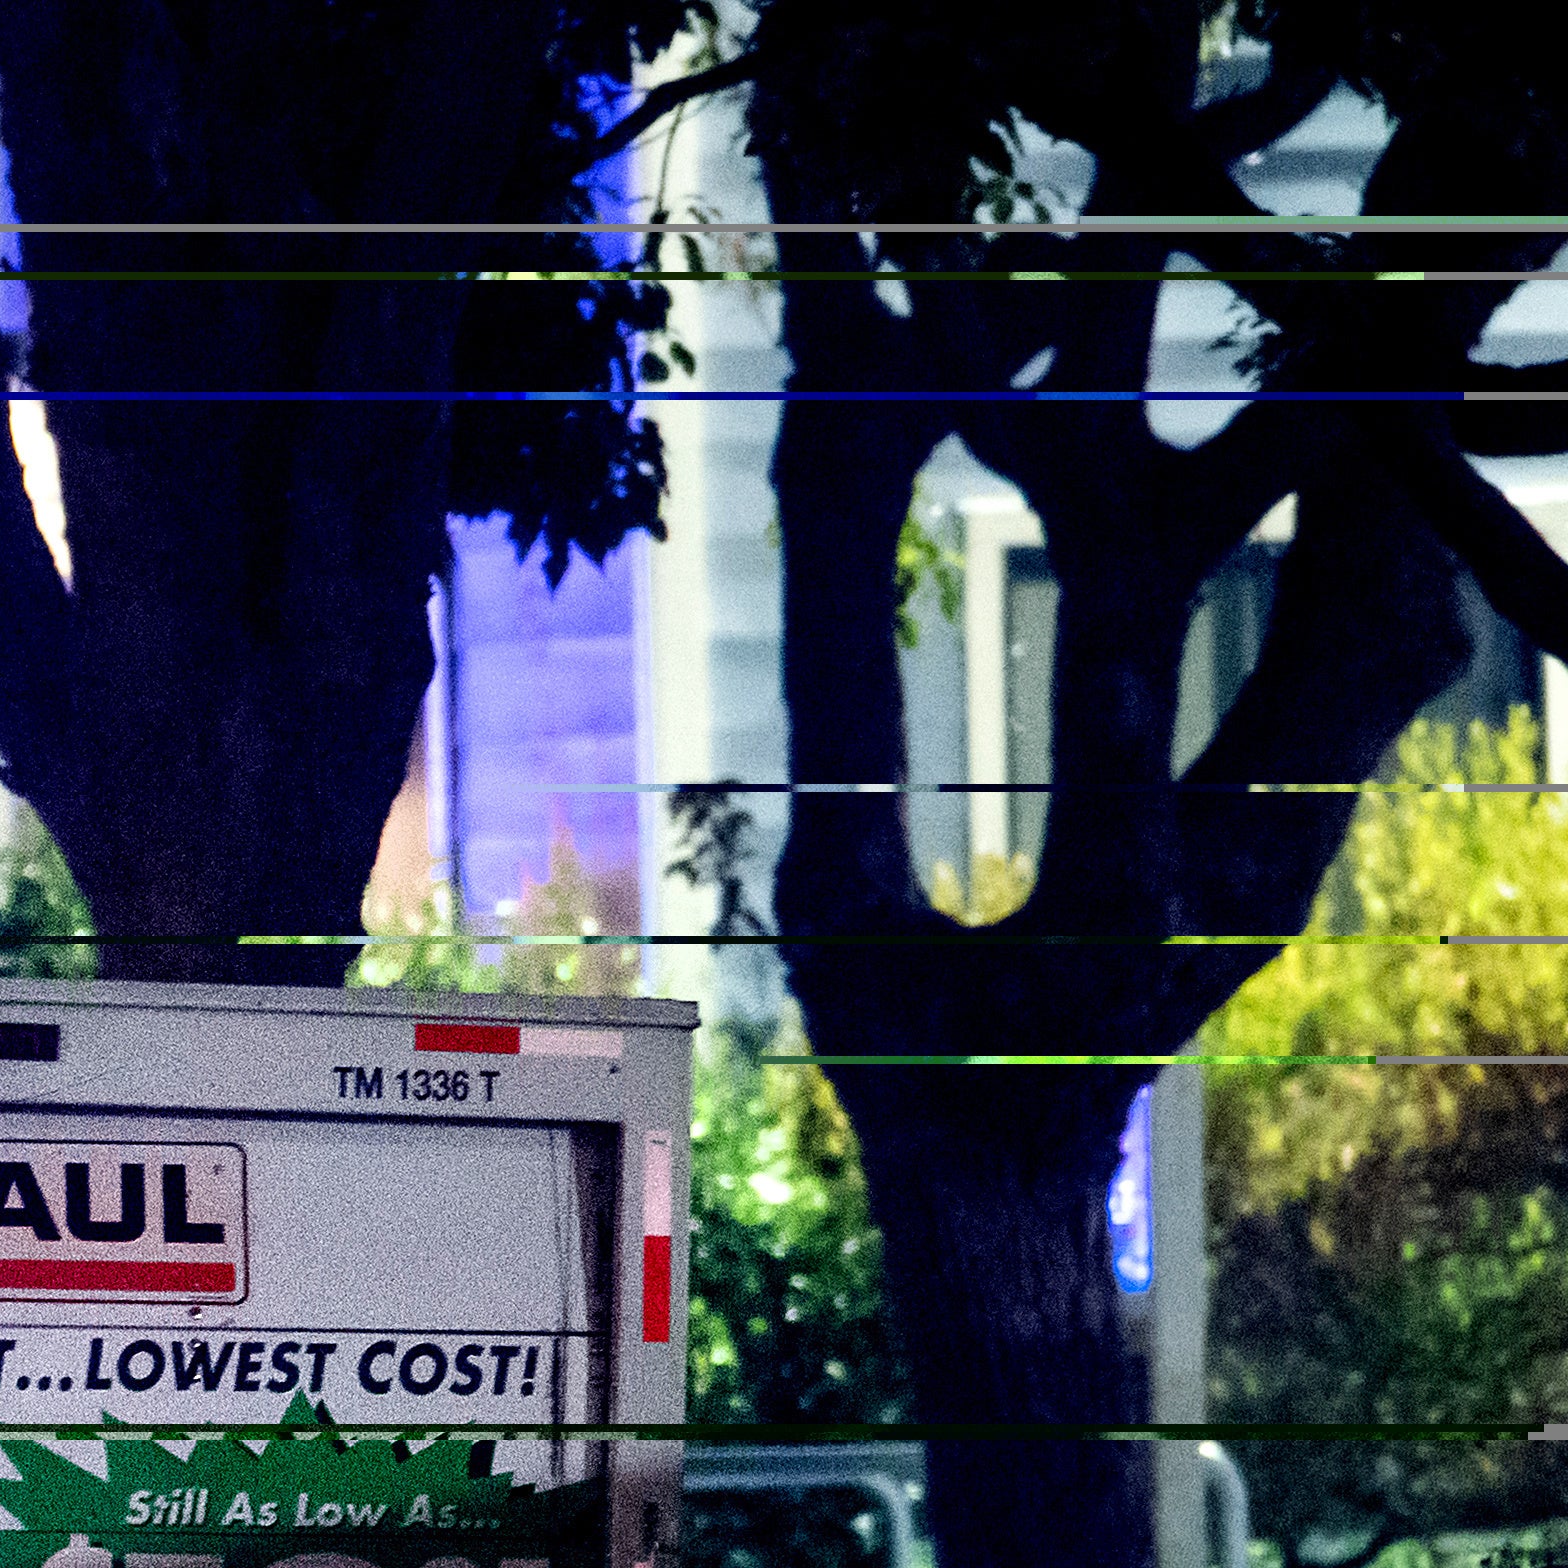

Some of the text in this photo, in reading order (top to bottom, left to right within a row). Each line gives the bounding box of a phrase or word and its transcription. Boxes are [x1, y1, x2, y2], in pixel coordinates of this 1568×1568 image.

[333, 1066, 501, 1101] TM 1336 T
[357, 1340, 540, 1396] COST!
[125, 1488, 209, 1526] Still
[221, 1491, 278, 1528] As
[294, 1492, 389, 1528] Low
